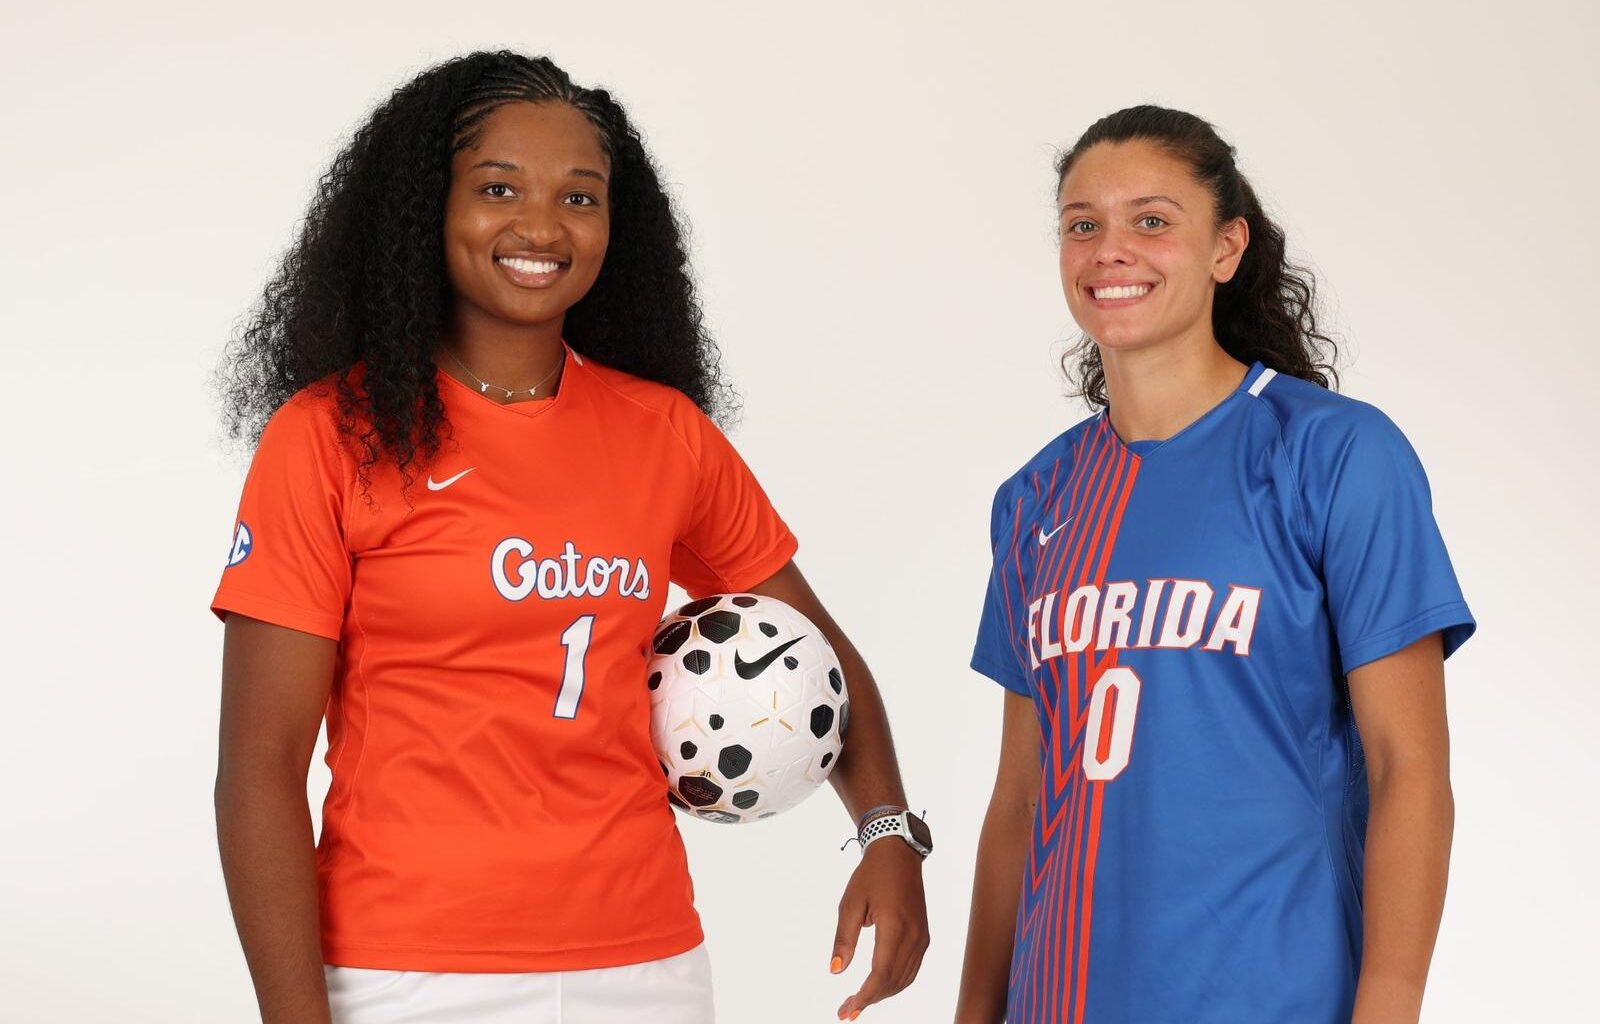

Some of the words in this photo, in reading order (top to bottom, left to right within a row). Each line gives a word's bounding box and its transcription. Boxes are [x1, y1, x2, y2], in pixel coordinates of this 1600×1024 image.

[491, 537, 650, 601] Gators
[553, 613, 596, 719] 1
[1028, 578, 1263, 671] FLORIDA
[1082, 665, 1142, 781] 0
[700, 770, 712, 778] UF
